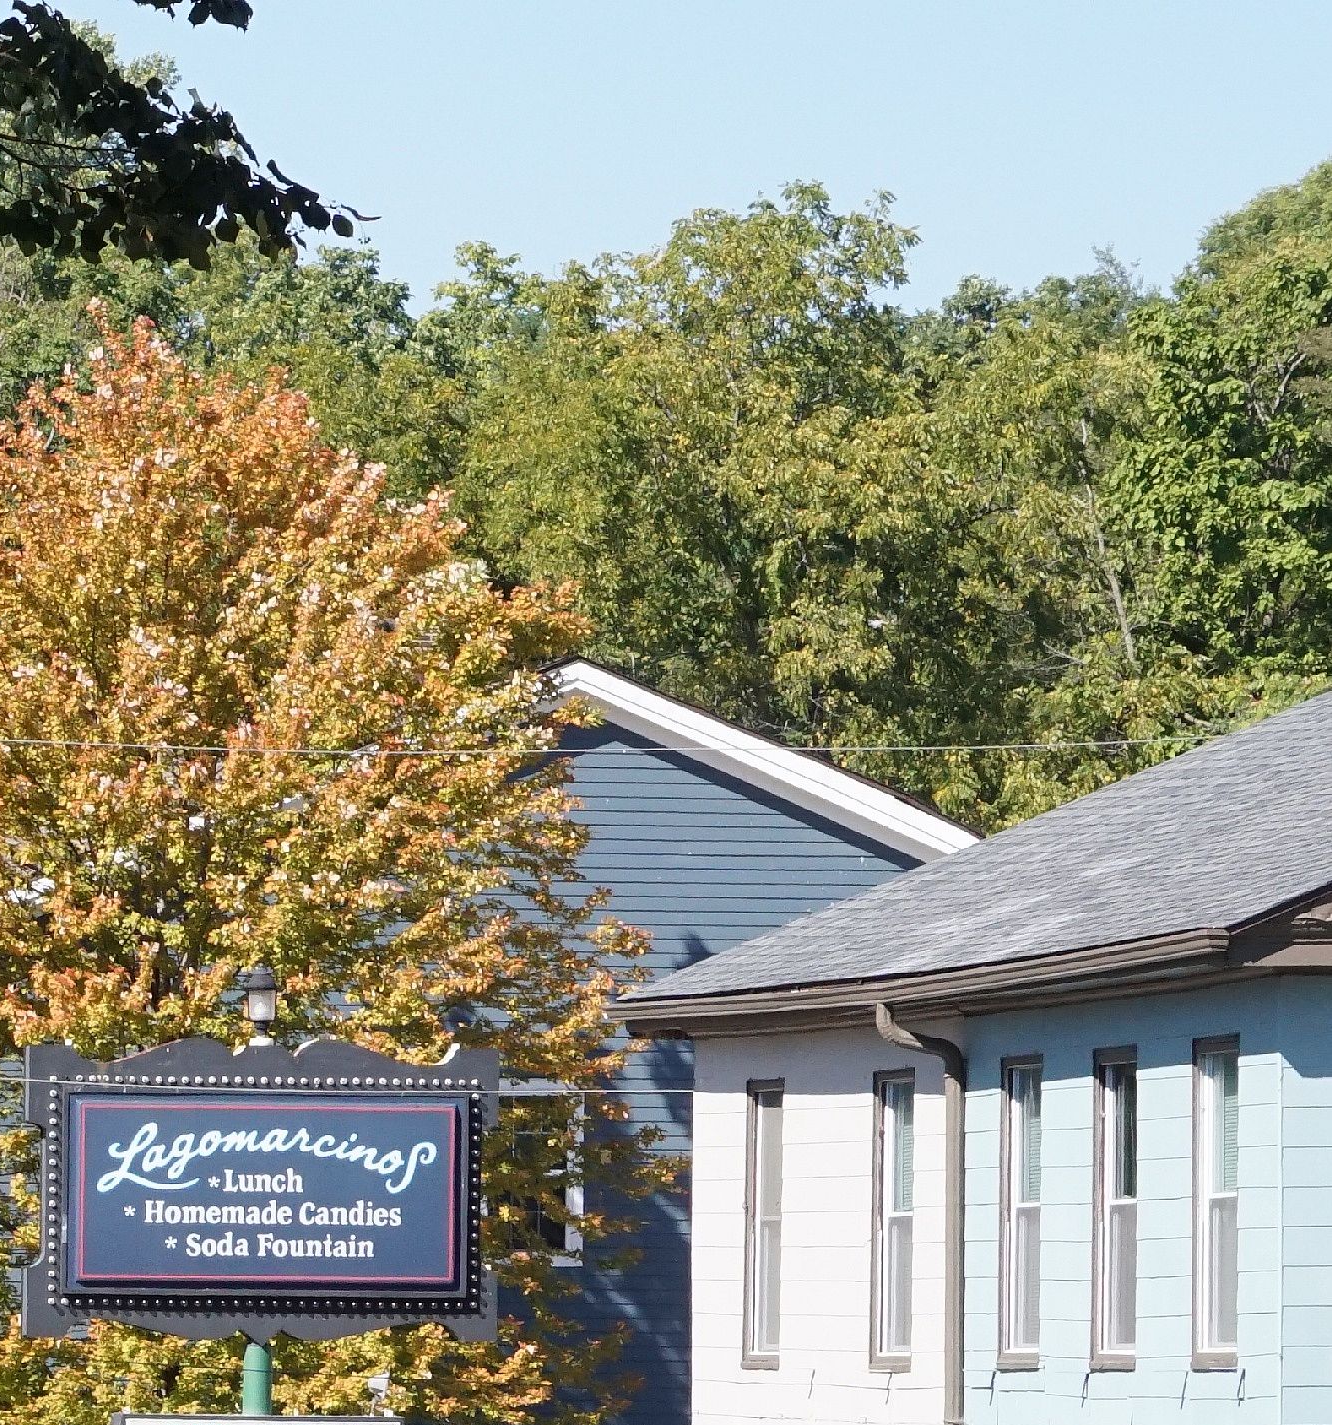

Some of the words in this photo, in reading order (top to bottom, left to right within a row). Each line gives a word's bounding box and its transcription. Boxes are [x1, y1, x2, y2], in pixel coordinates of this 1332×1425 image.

[223, 1168, 303, 1193] Lunch
[145, 1200, 293, 1226] Homemade
[299, 1202, 402, 1227] Candies
[186, 1232, 249, 1257] Soda
[257, 1233, 375, 1258] Fountain
